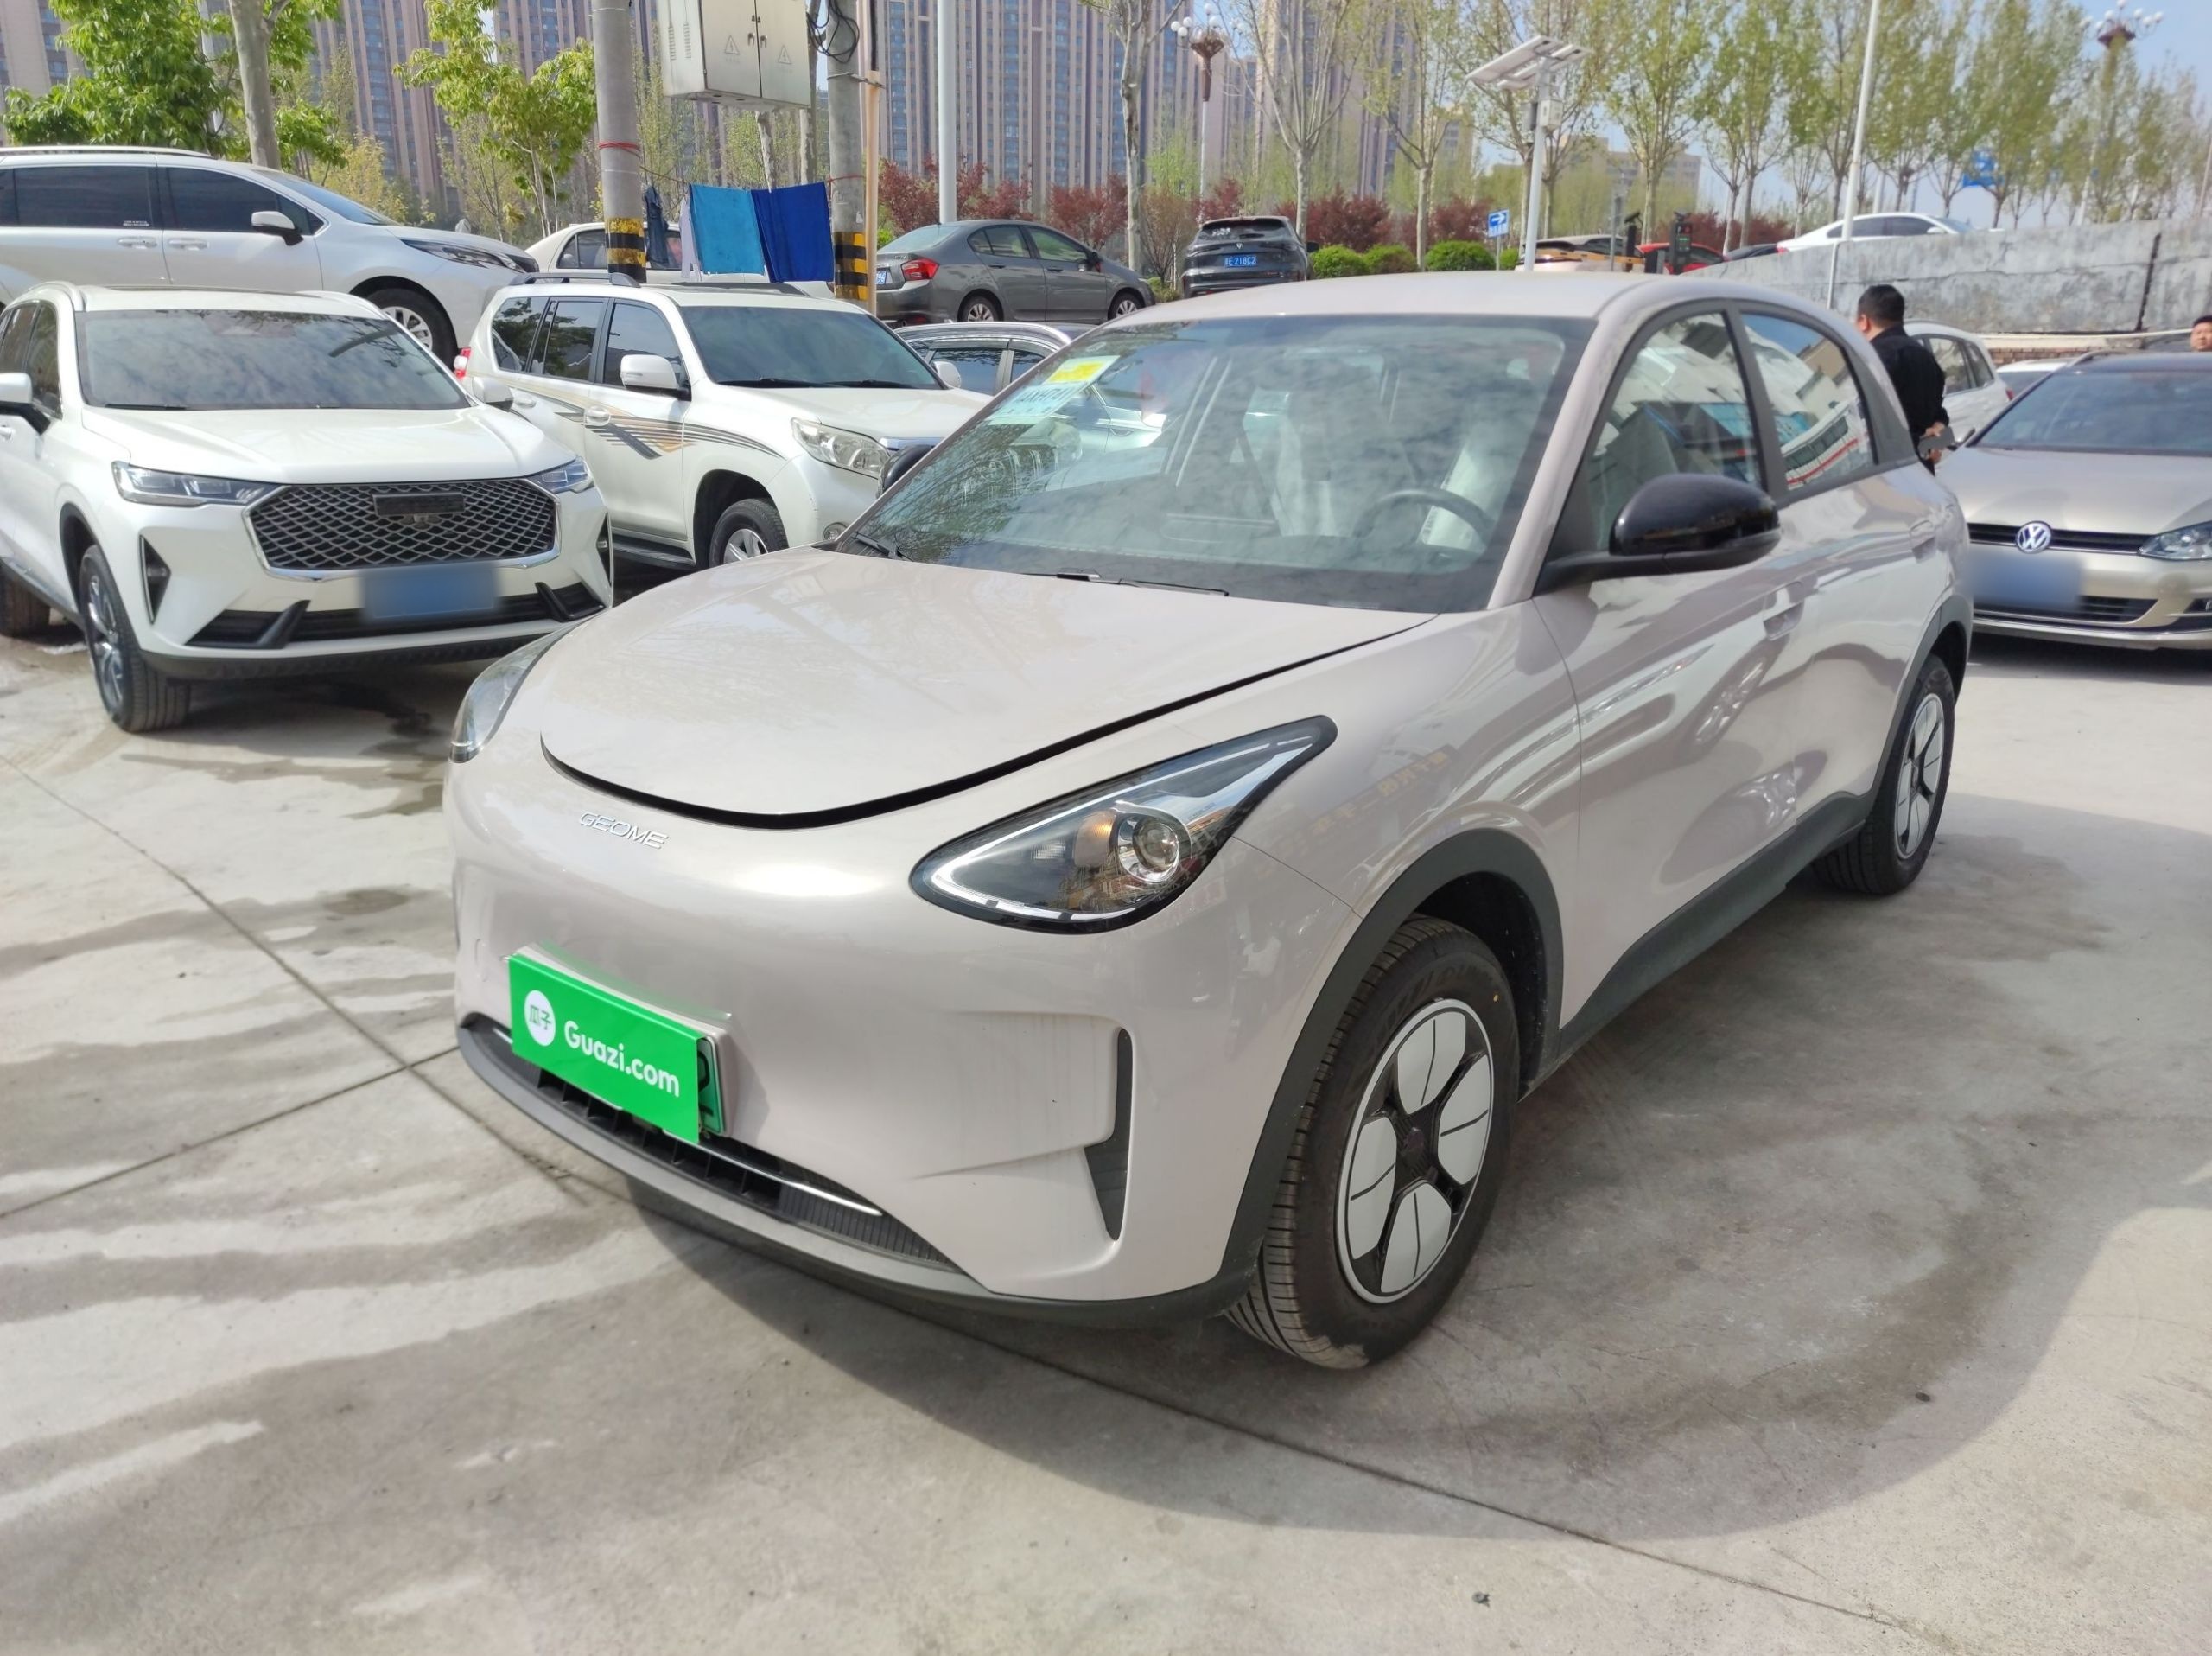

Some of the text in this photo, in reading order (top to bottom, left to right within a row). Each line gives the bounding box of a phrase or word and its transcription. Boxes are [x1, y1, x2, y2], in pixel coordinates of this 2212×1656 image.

[581, 812, 669, 849] GEOME
[530, 1004, 553, 1030] 瓜子
[564, 1020, 680, 1098] Guazi.com
